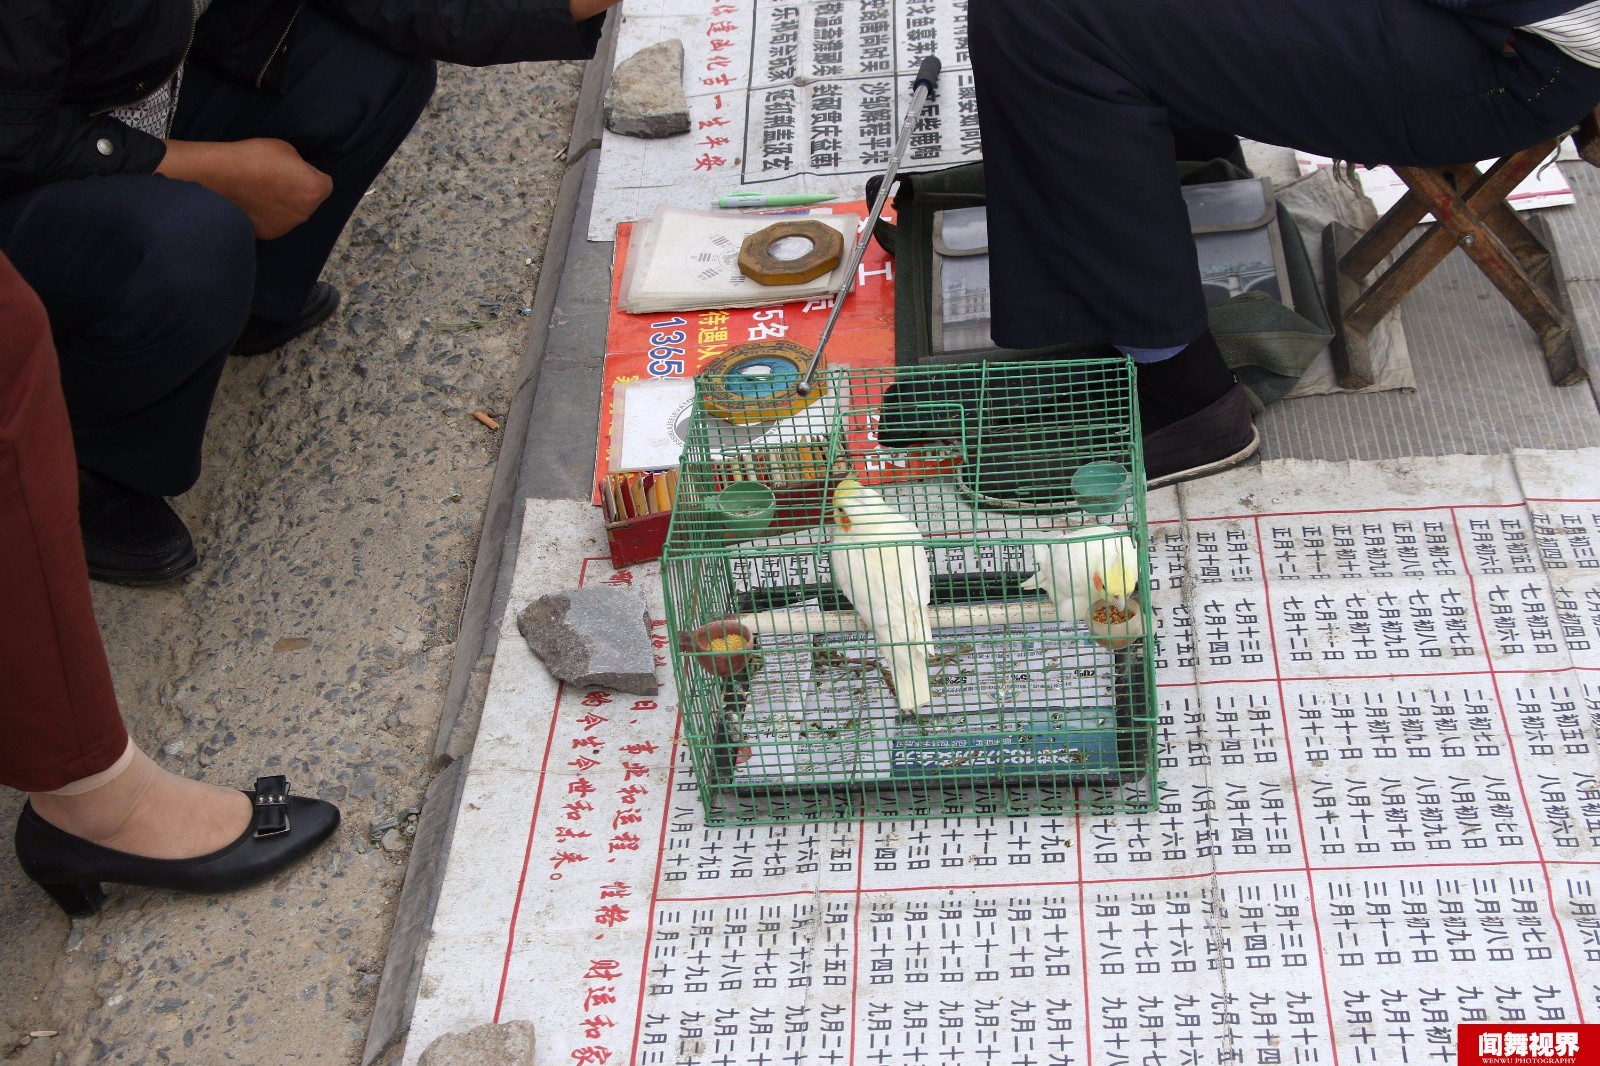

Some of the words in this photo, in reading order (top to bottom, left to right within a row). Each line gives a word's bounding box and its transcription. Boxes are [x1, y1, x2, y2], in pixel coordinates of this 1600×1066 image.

[648, 317, 687, 379] 1365
[697, 311, 729, 368] 待遇从
[1204, 600, 1232, 666] 七月十四日
[1235, 598, 1264, 664] 七月十三日
[1283, 596, 1313, 661] 七月十二日
[1346, 593, 1377, 659] 七月初十日
[1377, 591, 1409, 658] 七月初九日
[1408, 589, 1442, 658] 七月初八日
[1440, 587, 1475, 657] 七月初七日
[1488, 585, 1525, 655] 七月初六日
[1520, 583, 1558, 654] 七月初五日
[1216, 696, 1245, 764] 二月十四日
[1248, 694, 1278, 763] 二月十三日
[1299, 693, 1329, 761] 二月十二日
[1331, 692, 1363, 759] 二月十一日
[1364, 691, 1397, 758] 二月初十日
[1397, 690, 1431, 758] 二月初九日
[1430, 689, 1465, 757] 二月初八日
[1464, 688, 1501, 756] 二月初七日
[1515, 687, 1555, 756] 二月初六日
[1548, 686, 1590, 755] 二月初五日
